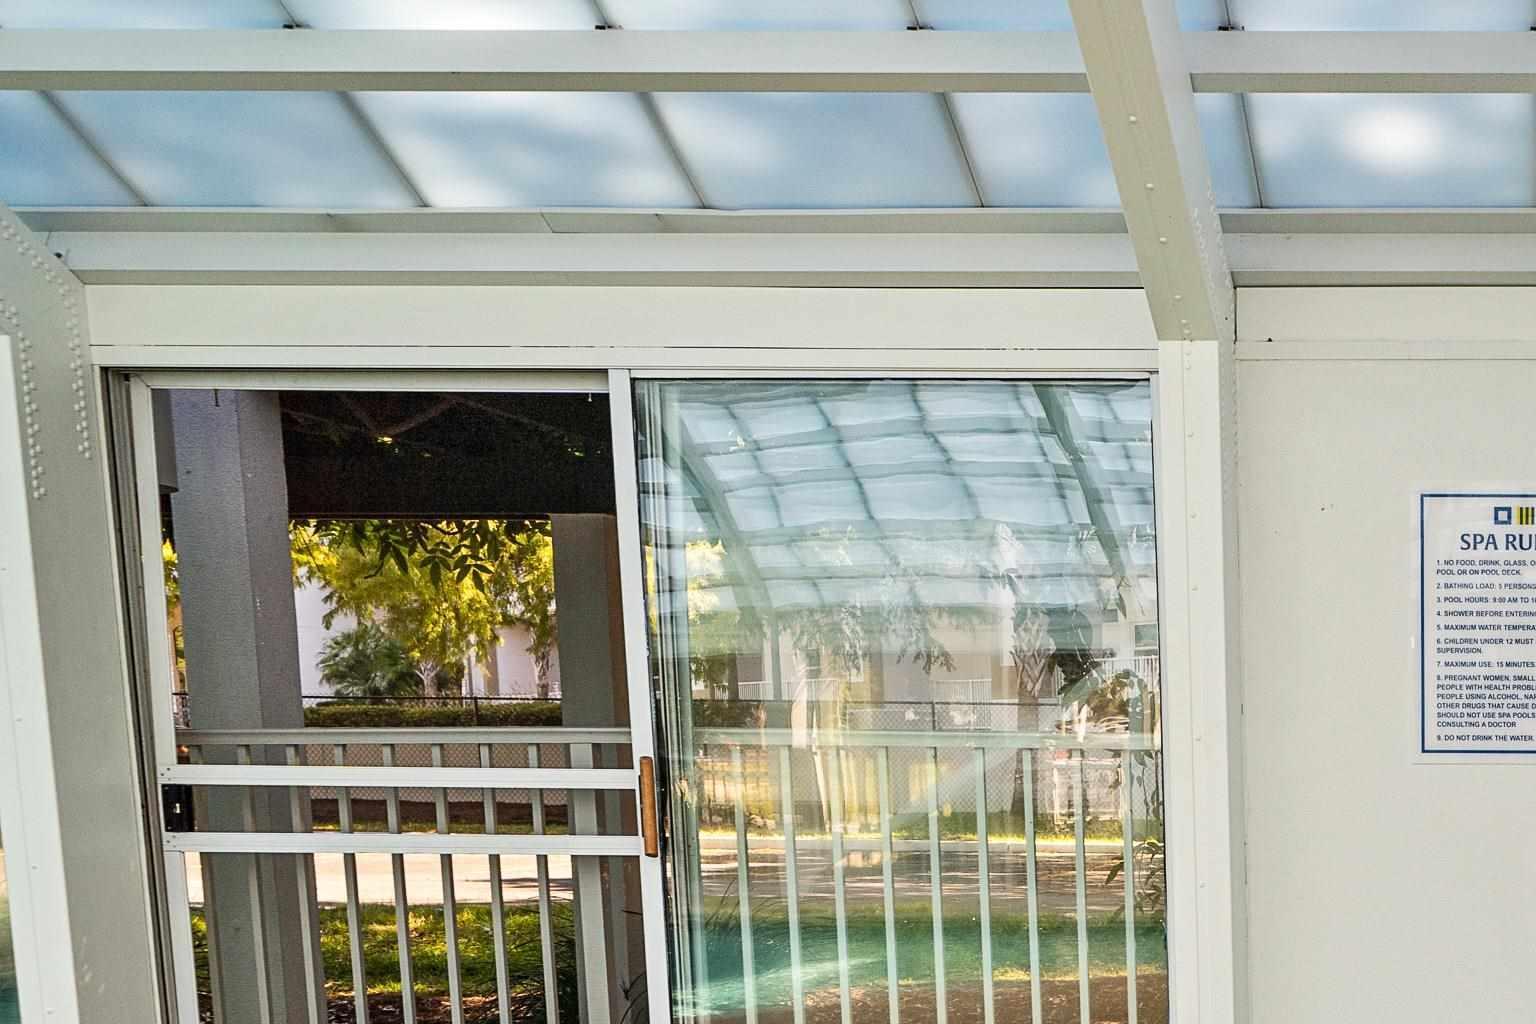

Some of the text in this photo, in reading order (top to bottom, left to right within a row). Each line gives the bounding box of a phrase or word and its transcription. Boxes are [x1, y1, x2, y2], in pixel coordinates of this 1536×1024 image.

[1460, 534, 1498, 551] SPA
[1436, 568, 1455, 576] POOL
[1515, 638, 1534, 646] MUST
[1436, 693, 1464, 701] PEOPLE
[1466, 693, 1487, 701] USING
[1436, 702, 1460, 710] OTHER
